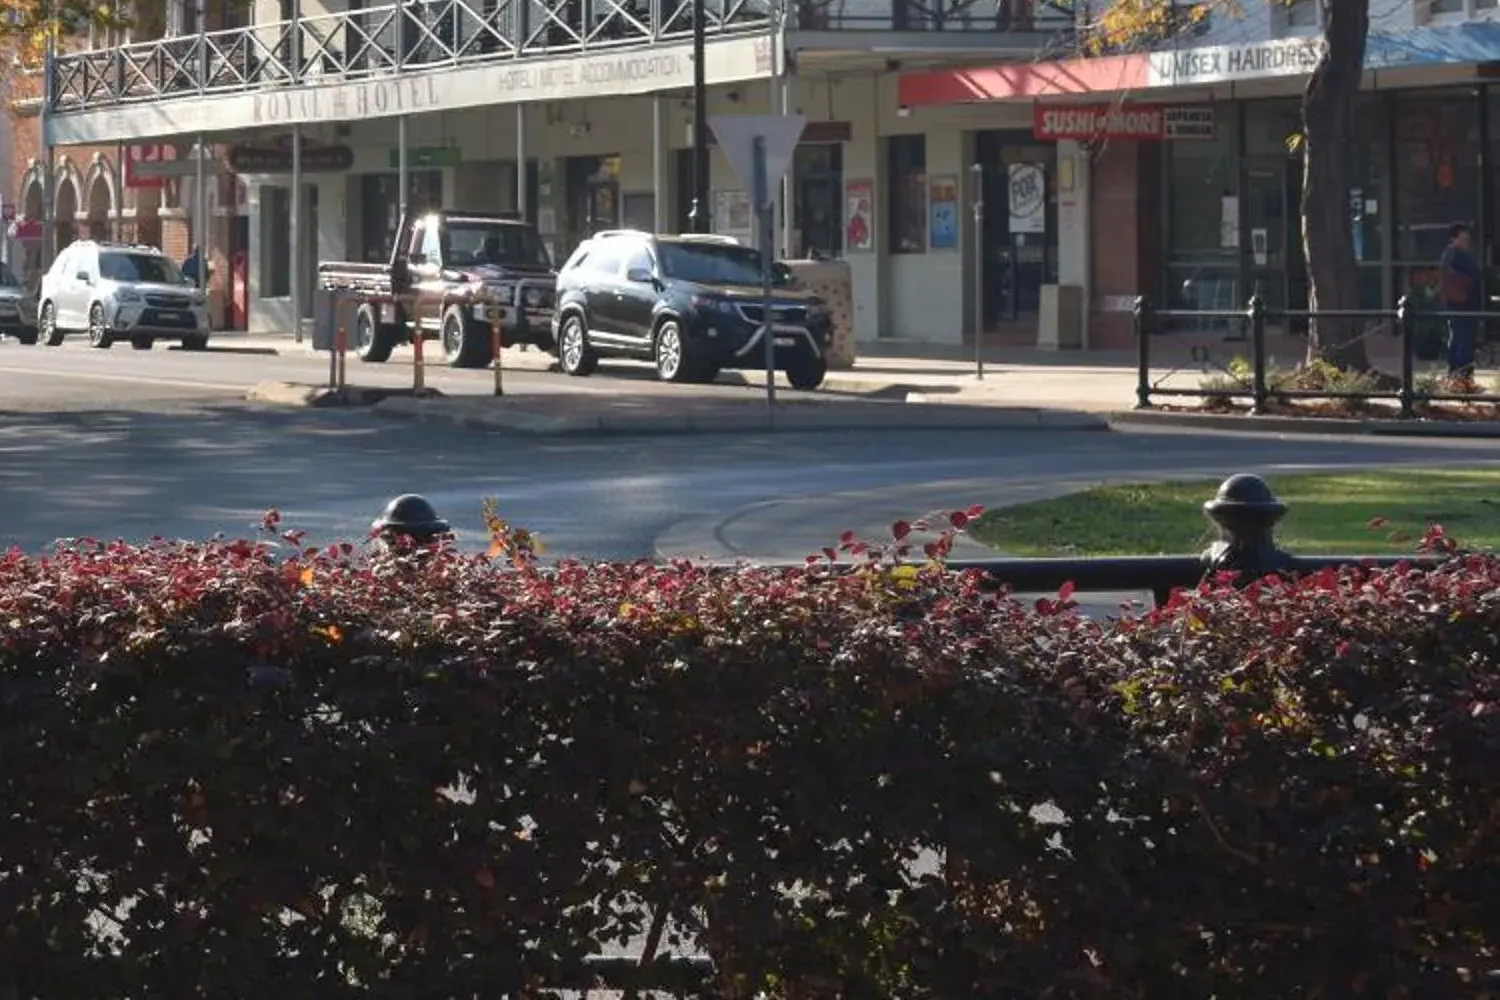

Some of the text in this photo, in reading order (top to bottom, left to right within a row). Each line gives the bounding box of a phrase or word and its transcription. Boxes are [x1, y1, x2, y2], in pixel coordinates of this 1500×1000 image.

[357, 76, 440, 114] HOTEL
[1042, 111, 1095, 133] SUSHI
[1107, 111, 1162, 133] MORE
